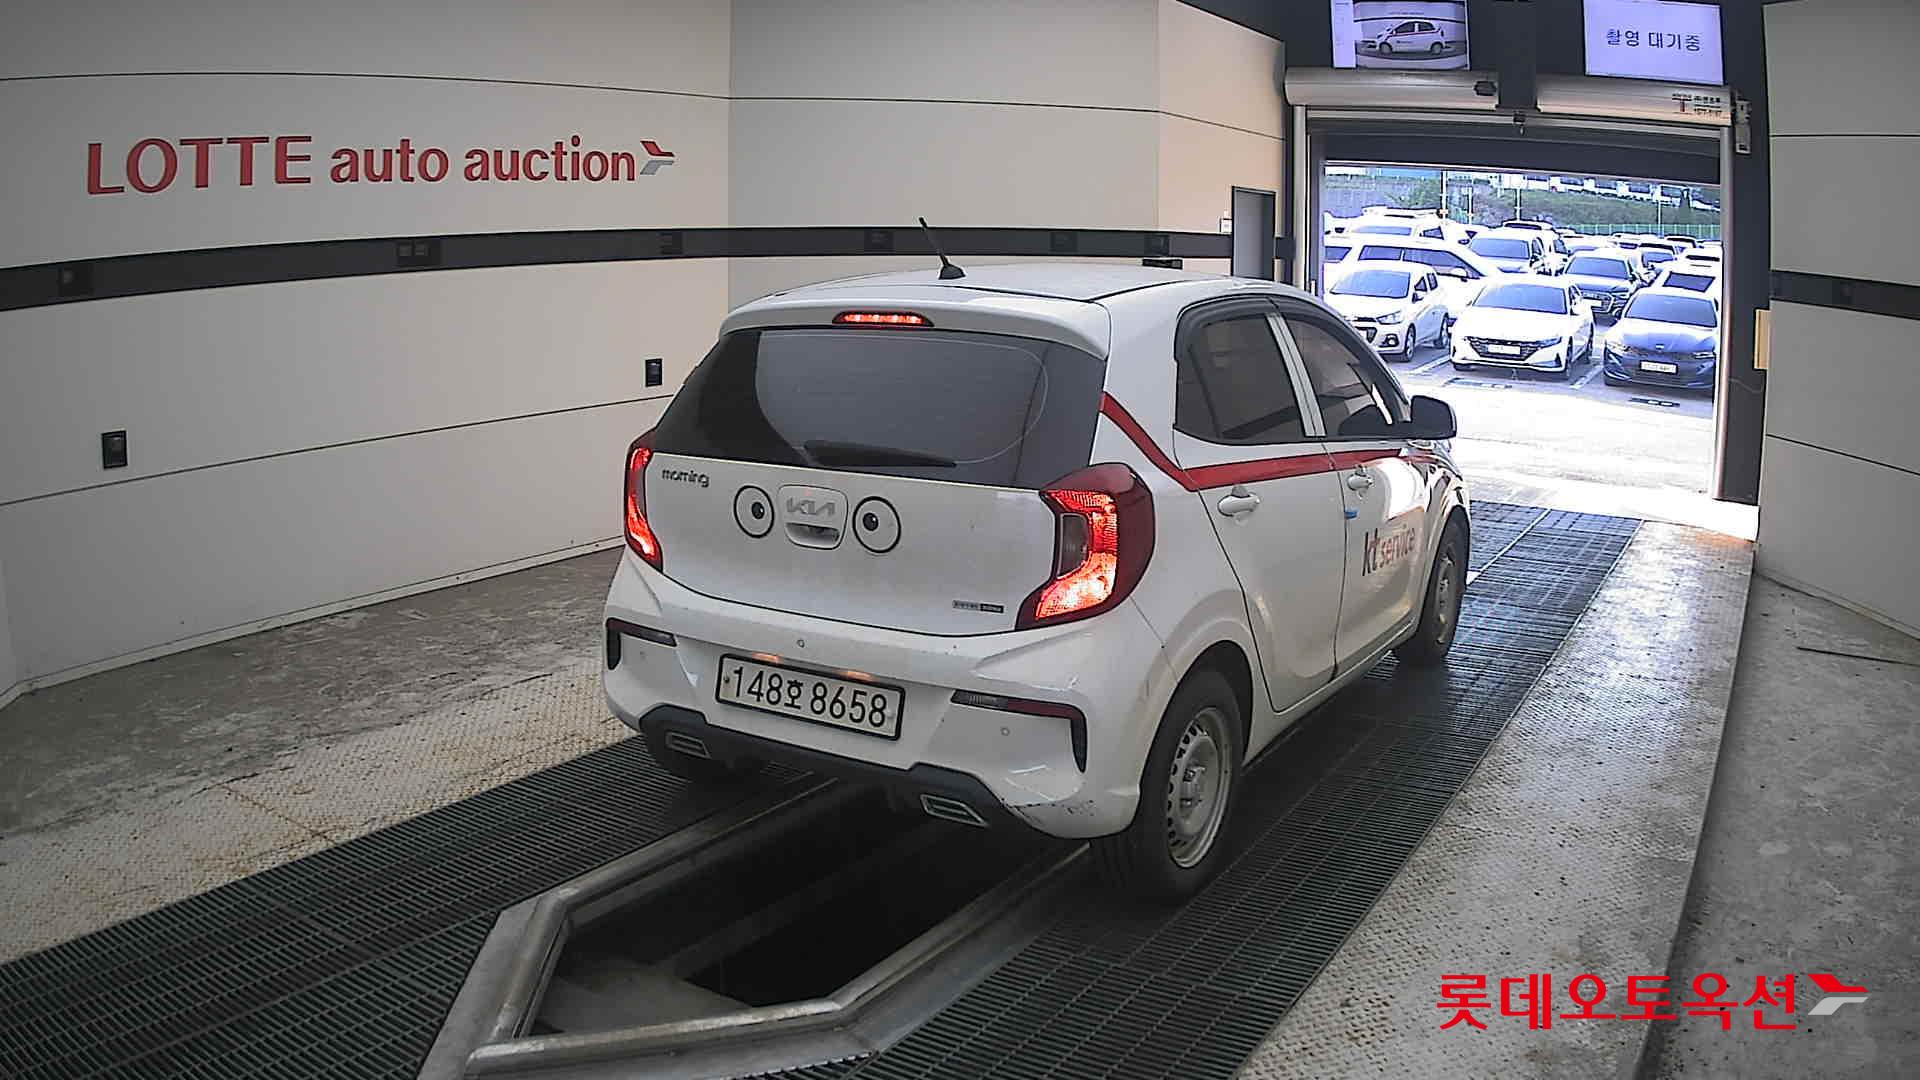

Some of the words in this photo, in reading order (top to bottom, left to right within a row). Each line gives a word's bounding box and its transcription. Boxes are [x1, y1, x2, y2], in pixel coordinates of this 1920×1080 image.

[86, 136, 312, 195] LOTTE
[330, 138, 449, 184] auto
[464, 135, 637, 182] auction
[810, 682, 888, 727] 8658
